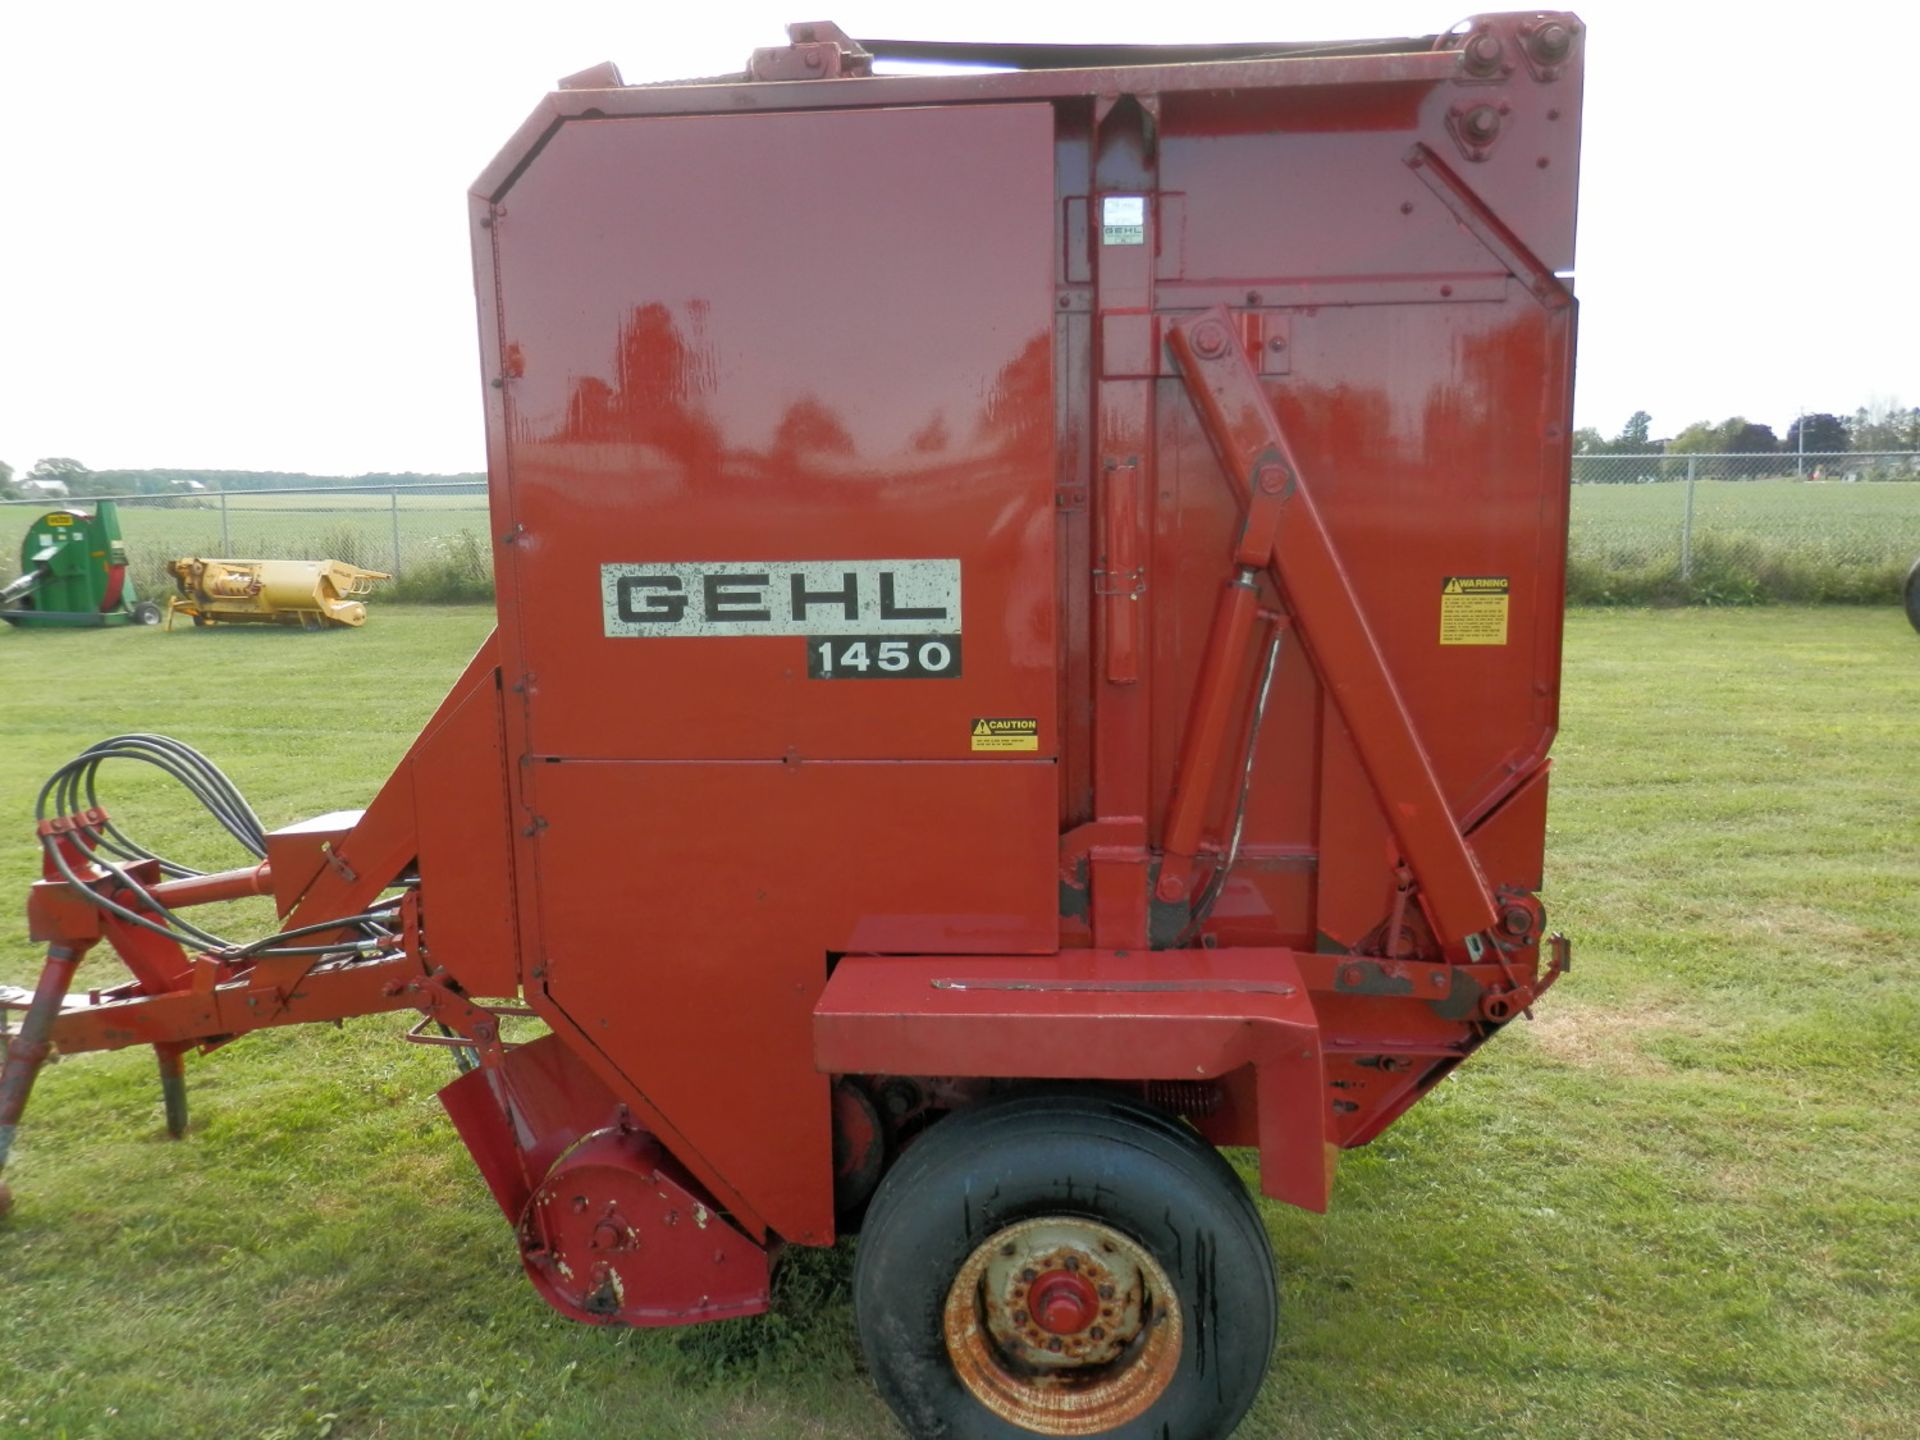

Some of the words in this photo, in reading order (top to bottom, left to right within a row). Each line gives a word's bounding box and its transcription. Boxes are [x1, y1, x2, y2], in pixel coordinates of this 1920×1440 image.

[1459, 578, 1508, 587] WARNING
[616, 572, 948, 623] GEHL
[817, 641, 952, 672] 1450
[989, 720, 1036, 729] CAUTION
